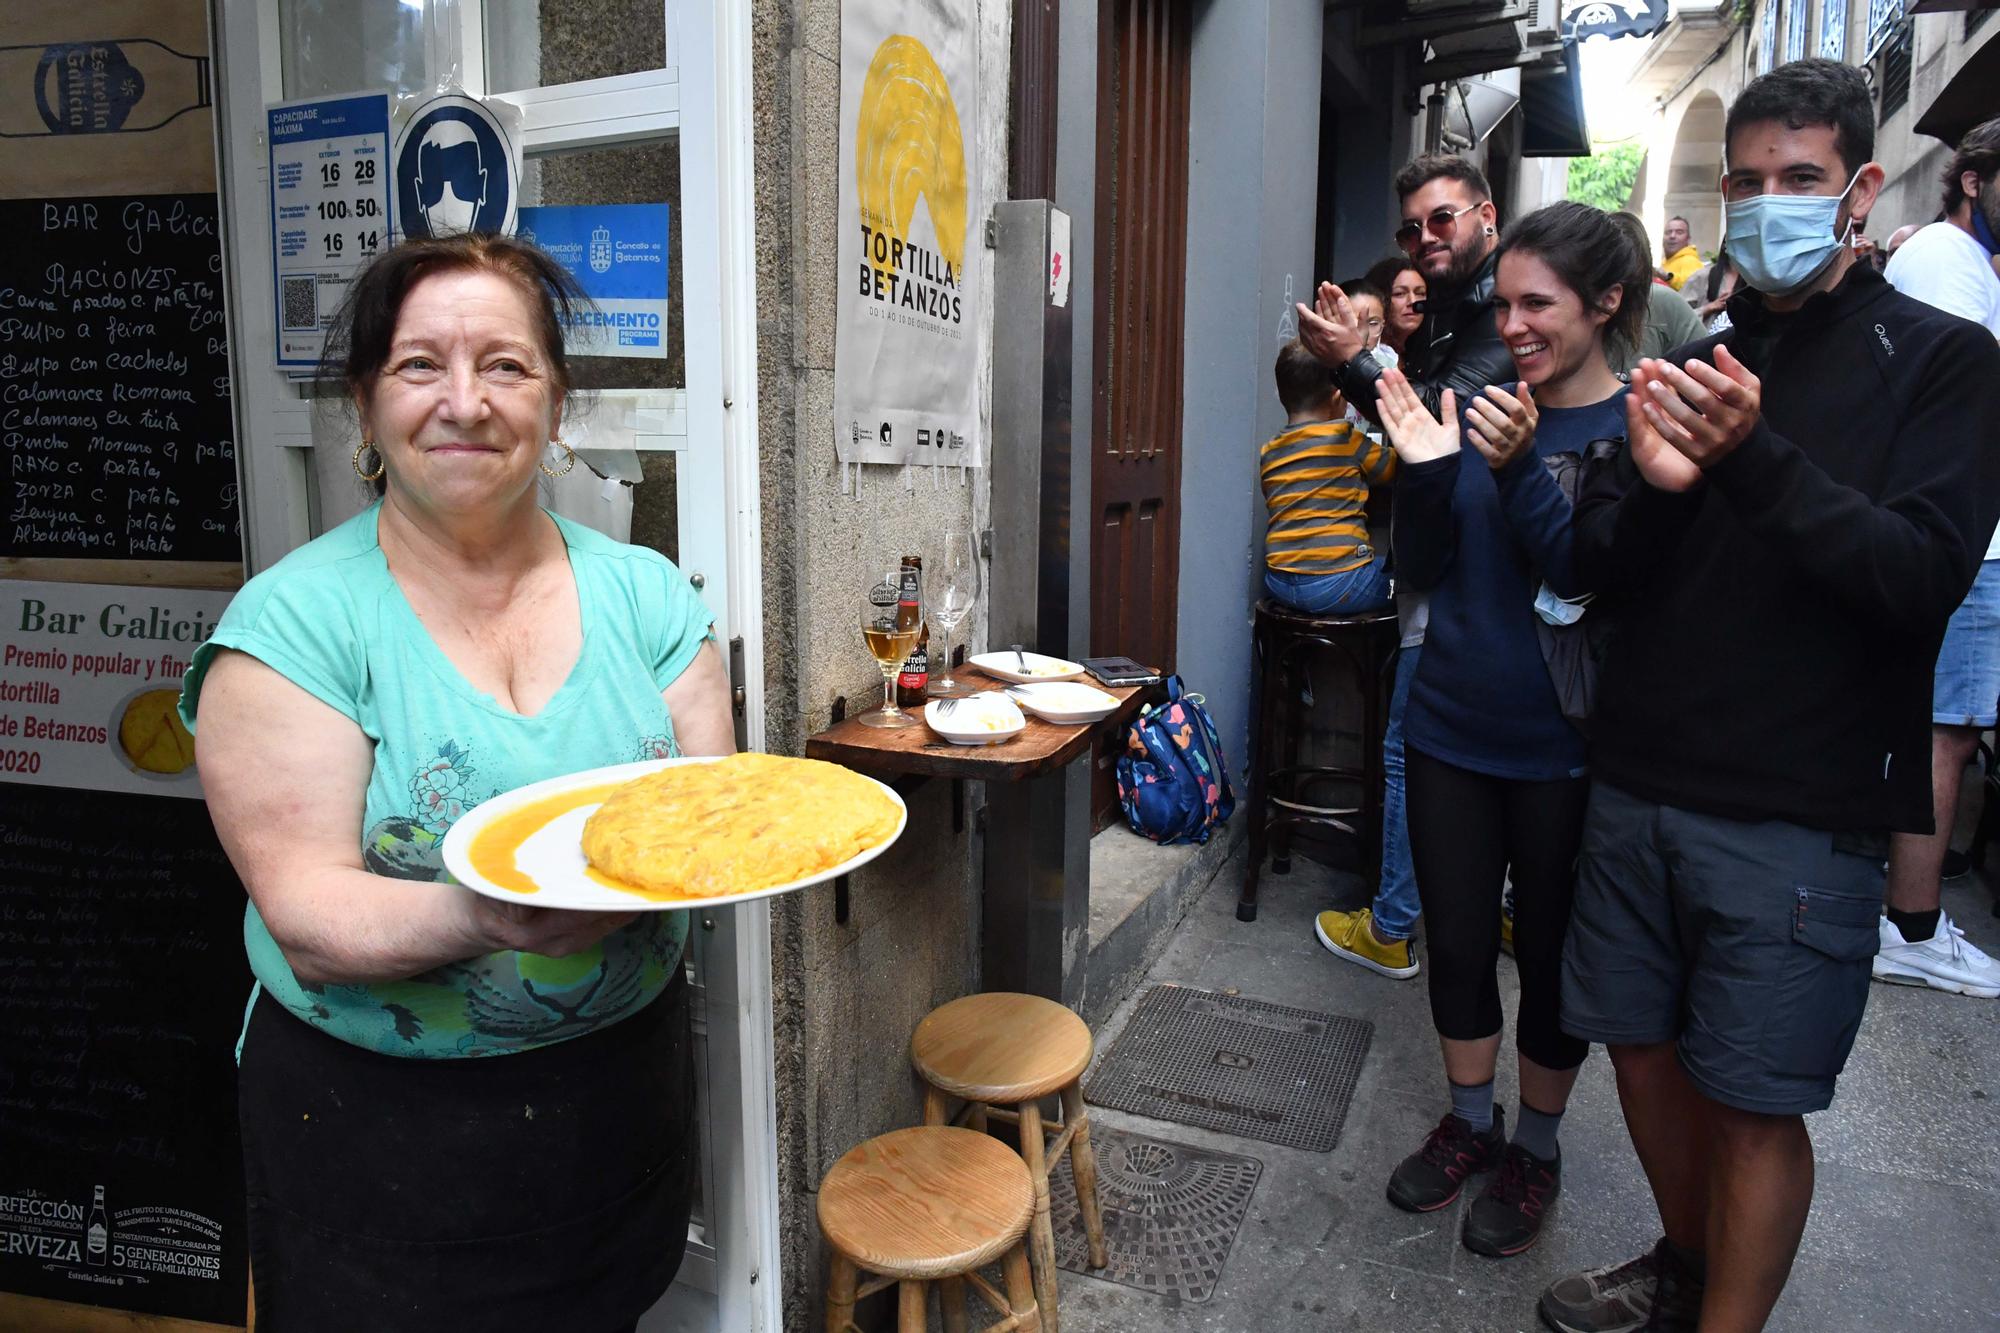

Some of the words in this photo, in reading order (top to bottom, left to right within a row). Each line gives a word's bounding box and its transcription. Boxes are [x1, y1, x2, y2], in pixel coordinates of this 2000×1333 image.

[66, 51, 88, 127] Galicia
[91, 48, 111, 129] Estrella
[273, 109, 318, 124] CAPACIDADE
[274, 123, 303, 135] MÁXIMA
[320, 163, 340, 182] 16
[354, 160, 375, 179] 28
[44, 202, 99, 232] BAR
[323, 233, 343, 252] 16
[357, 231, 378, 250] 14
[861, 224, 955, 289] TORTILLA
[860, 264, 961, 324] BETANZOS
[0, 318, 65, 342] Pulpo
[106, 316, 156, 345] feira
[620, 330, 658, 338] PROGRAMA
[0, 353, 59, 378] Pulpo
[3, 381, 104, 404] Calamares
[112, 382, 197, 404] Romana
[2, 406, 99, 431] Calamares
[18, 598, 86, 634] Bar
[4, 644, 67, 671] Premio
[72, 652, 141, 678] popular
[144, 660, 155, 681] y
[0, 680, 60, 705] tortilla
[23, 715, 107, 745] Betanzos
[26, 1188, 38, 1199] LA
[33, 1217, 84, 1231] ELABORACIÓN
[114, 1210, 124, 1219] ES
[124, 1209, 132, 1217] EL
[155, 1206, 164, 1214] DE
[165, 1207, 180, 1216] UNA
[180, 1209, 222, 1232] EXPERIENCIA
[116, 1216, 156, 1228] TRANSMITIDA
[161, 1216, 183, 1226] TRAVÉS
[183, 1220, 192, 1229] DE
[192, 1223, 204, 1233] LOS
[203, 1228, 221, 1241] AÑOS
[165, 1226, 172, 1235] Y
[112, 1231, 172, 1245] CONSTANTEMENTE
[172, 1239, 207, 1251] MEJORADA
[207, 1243, 222, 1252] POR
[112, 1244, 126, 1267] 5
[126, 1246, 221, 1270] GENERACIONES
[127, 1259, 139, 1269] DE
[140, 1261, 151, 1270] LA
[152, 1262, 187, 1276] FAMILIA
[187, 1267, 220, 1280] RIVERA
